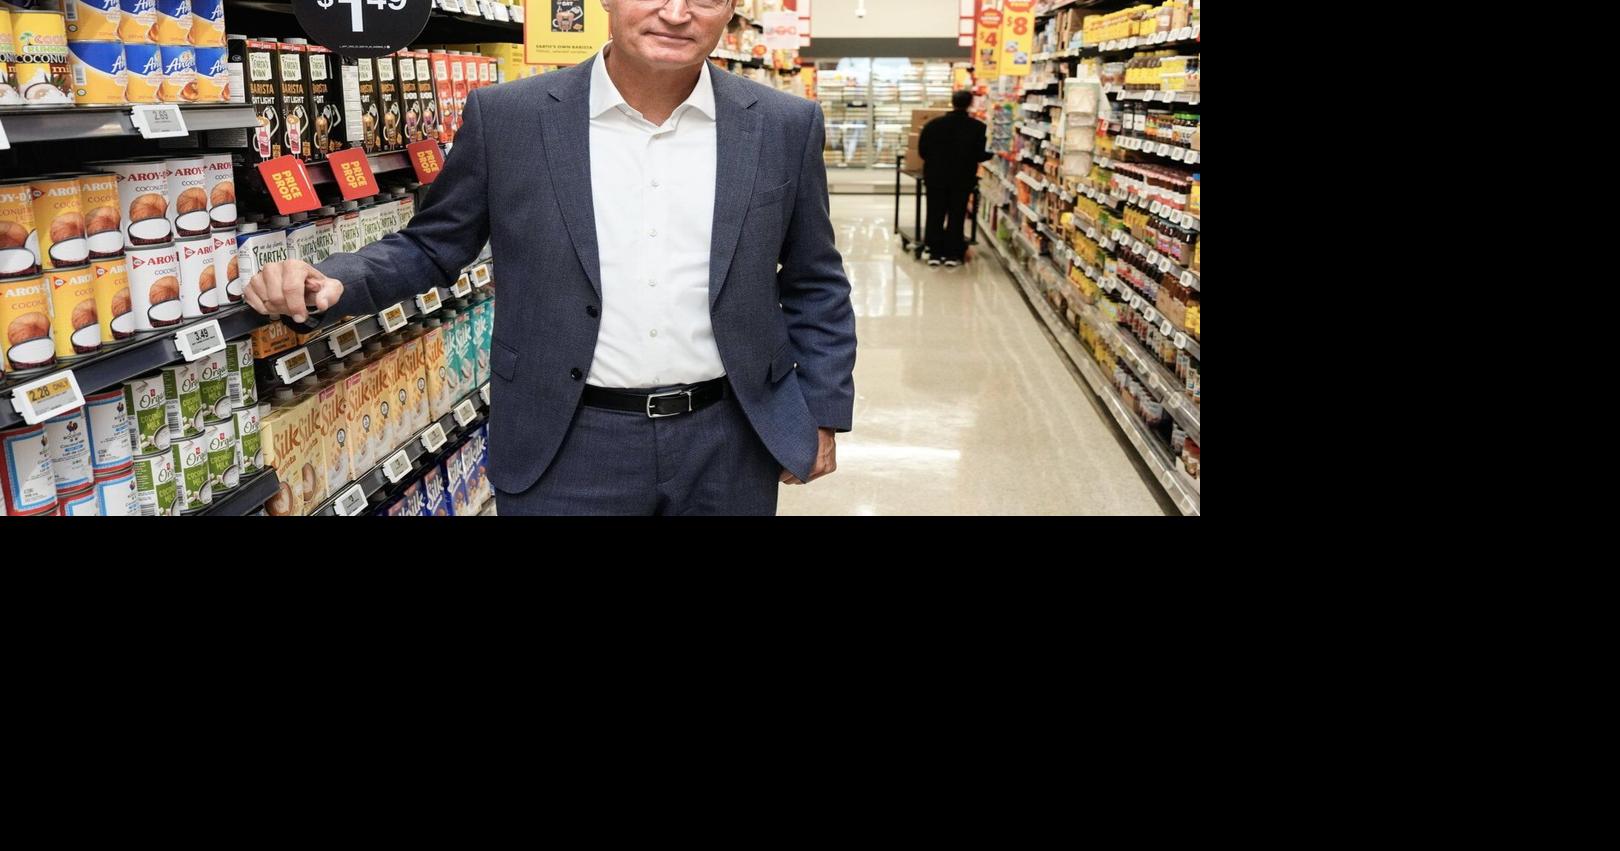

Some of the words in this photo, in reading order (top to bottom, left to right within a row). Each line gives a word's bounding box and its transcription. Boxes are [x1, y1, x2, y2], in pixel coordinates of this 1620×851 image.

[350, 160, 368, 187] PRICE
[416, 151, 432, 174] DROP
[425, 149, 440, 172] PRICE
[271, 172, 293, 201] DROP
[281, 169, 303, 199] PRICE
[340, 162, 358, 189] DROP
[259, 246, 288, 267] EARTH'S
[194, 328, 209, 341] 3.49
[29, 385, 51, 402] 2.28
[52, 379, 69, 391] ONLY
[347, 381, 371, 421] Silk
[321, 393, 345, 437] Silk
[271, 423, 300, 470] Silk
